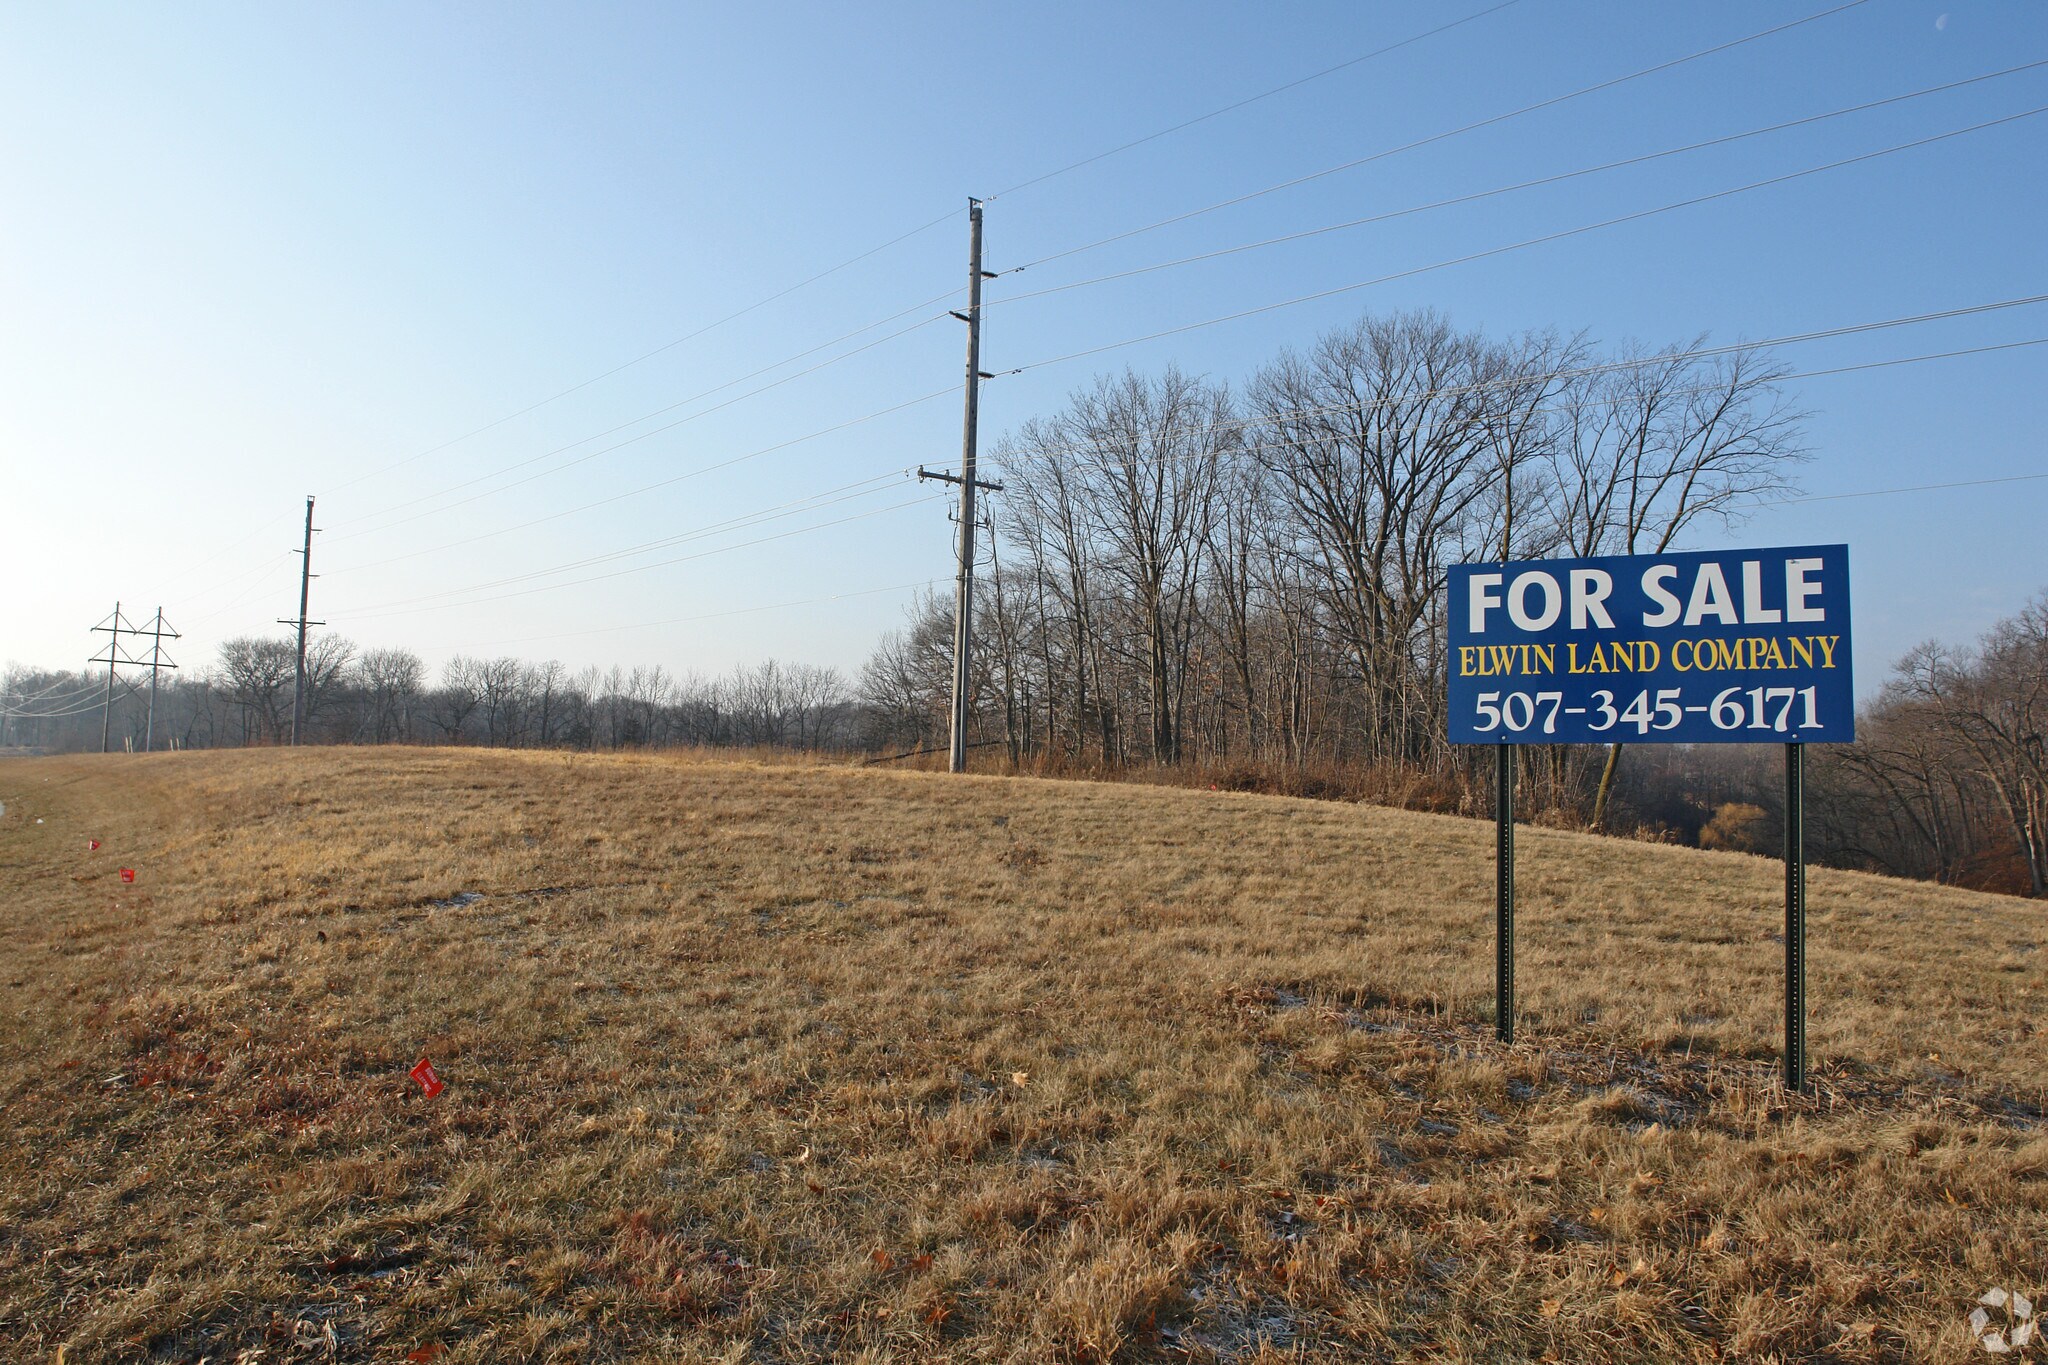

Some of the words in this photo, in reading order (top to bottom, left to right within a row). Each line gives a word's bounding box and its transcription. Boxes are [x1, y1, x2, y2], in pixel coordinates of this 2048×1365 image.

[1469, 569, 1616, 633] FOR
[1641, 558, 1825, 627] SALE
[1459, 644, 1556, 676] ELWIN
[1566, 640, 1661, 673] LAND
[1671, 635, 1840, 672] COMPANY
[1473, 685, 1824, 735] 507-345-6171
